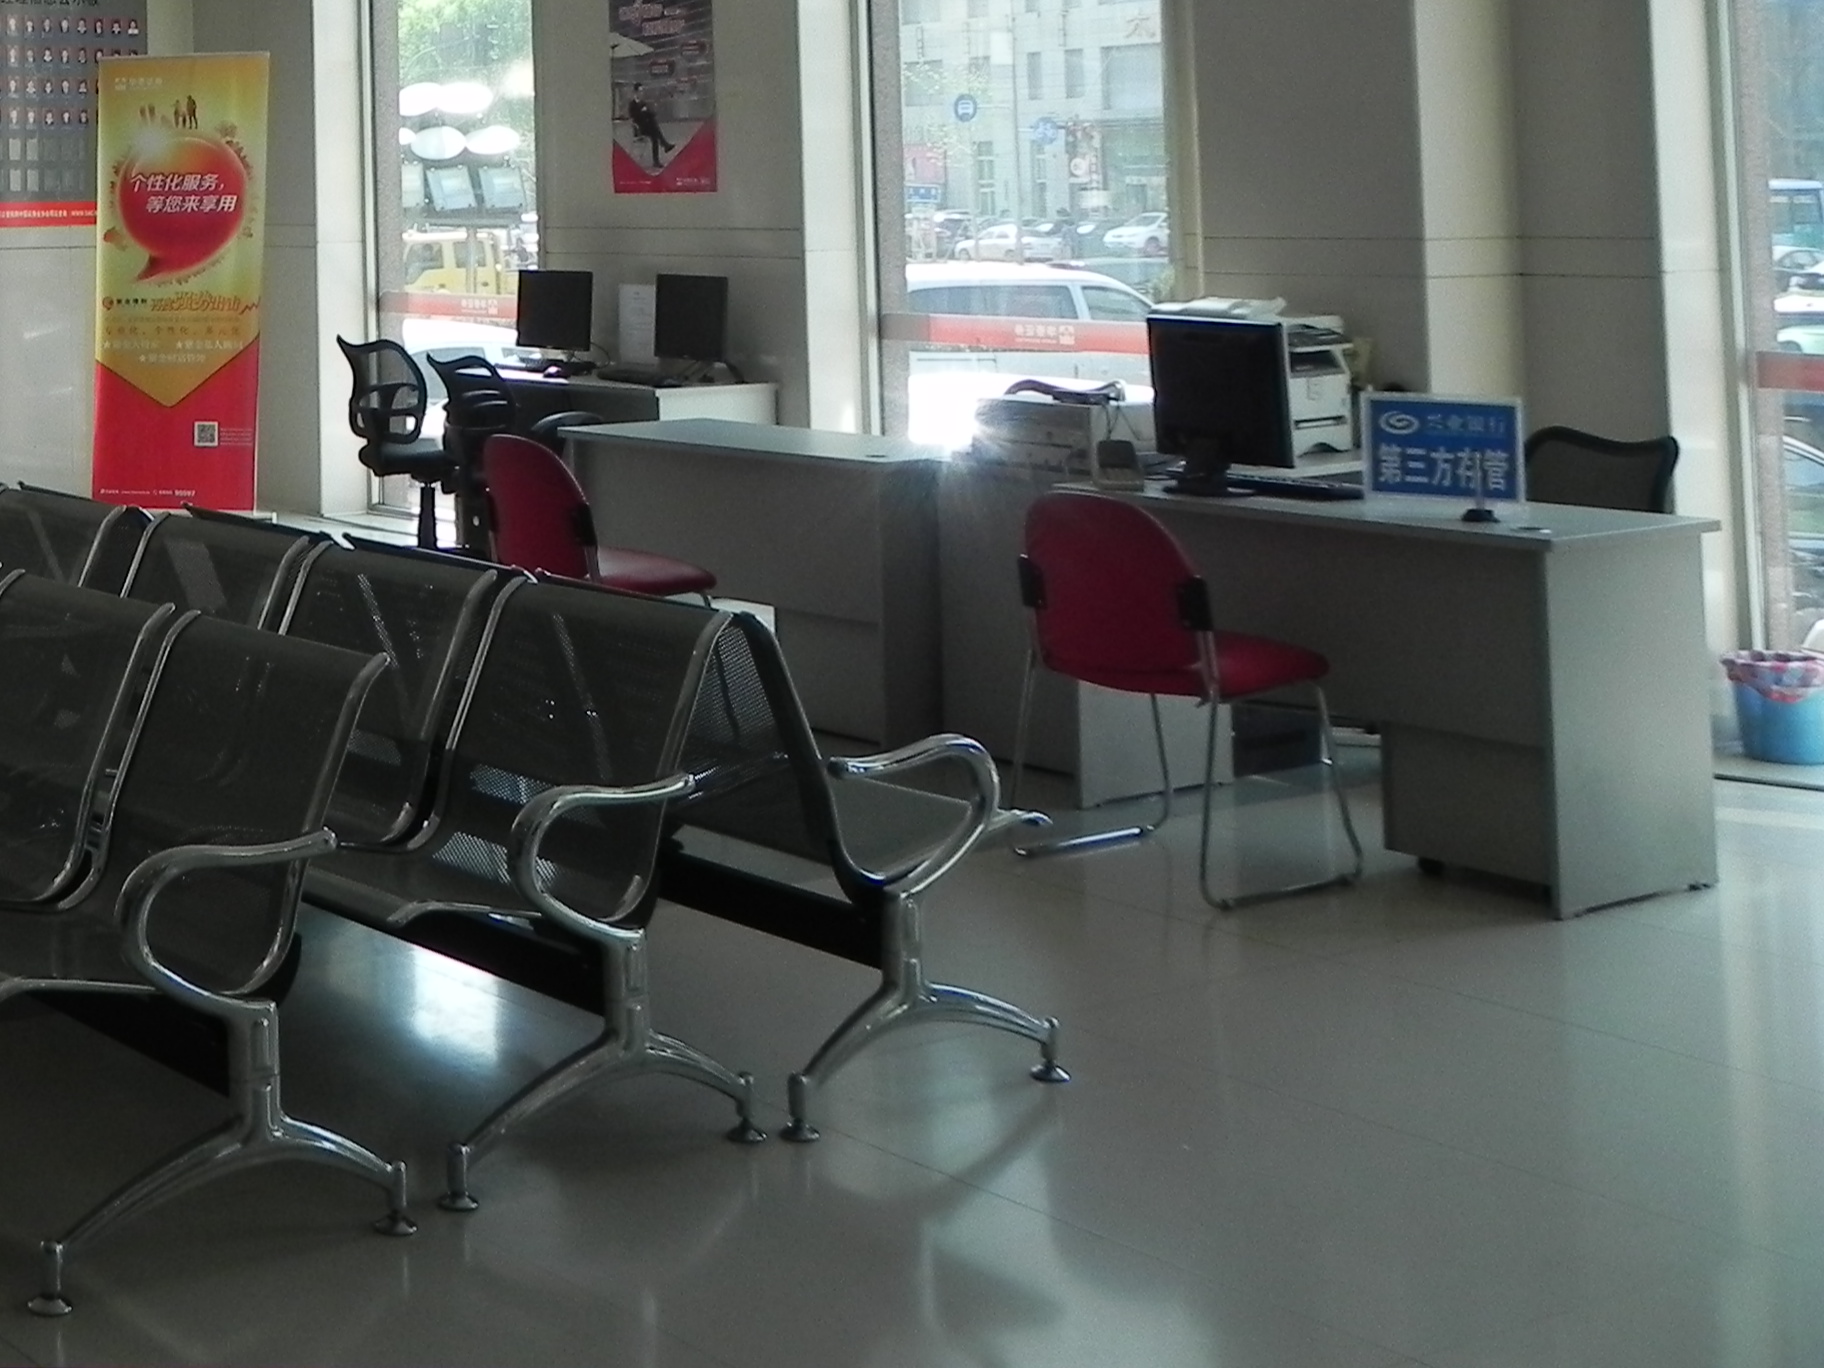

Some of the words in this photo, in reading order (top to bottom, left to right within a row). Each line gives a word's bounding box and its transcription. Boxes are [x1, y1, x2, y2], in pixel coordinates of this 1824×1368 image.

[146, 194, 238, 214] 等您来享用
[1378, 443, 1509, 492] 第三方存管
